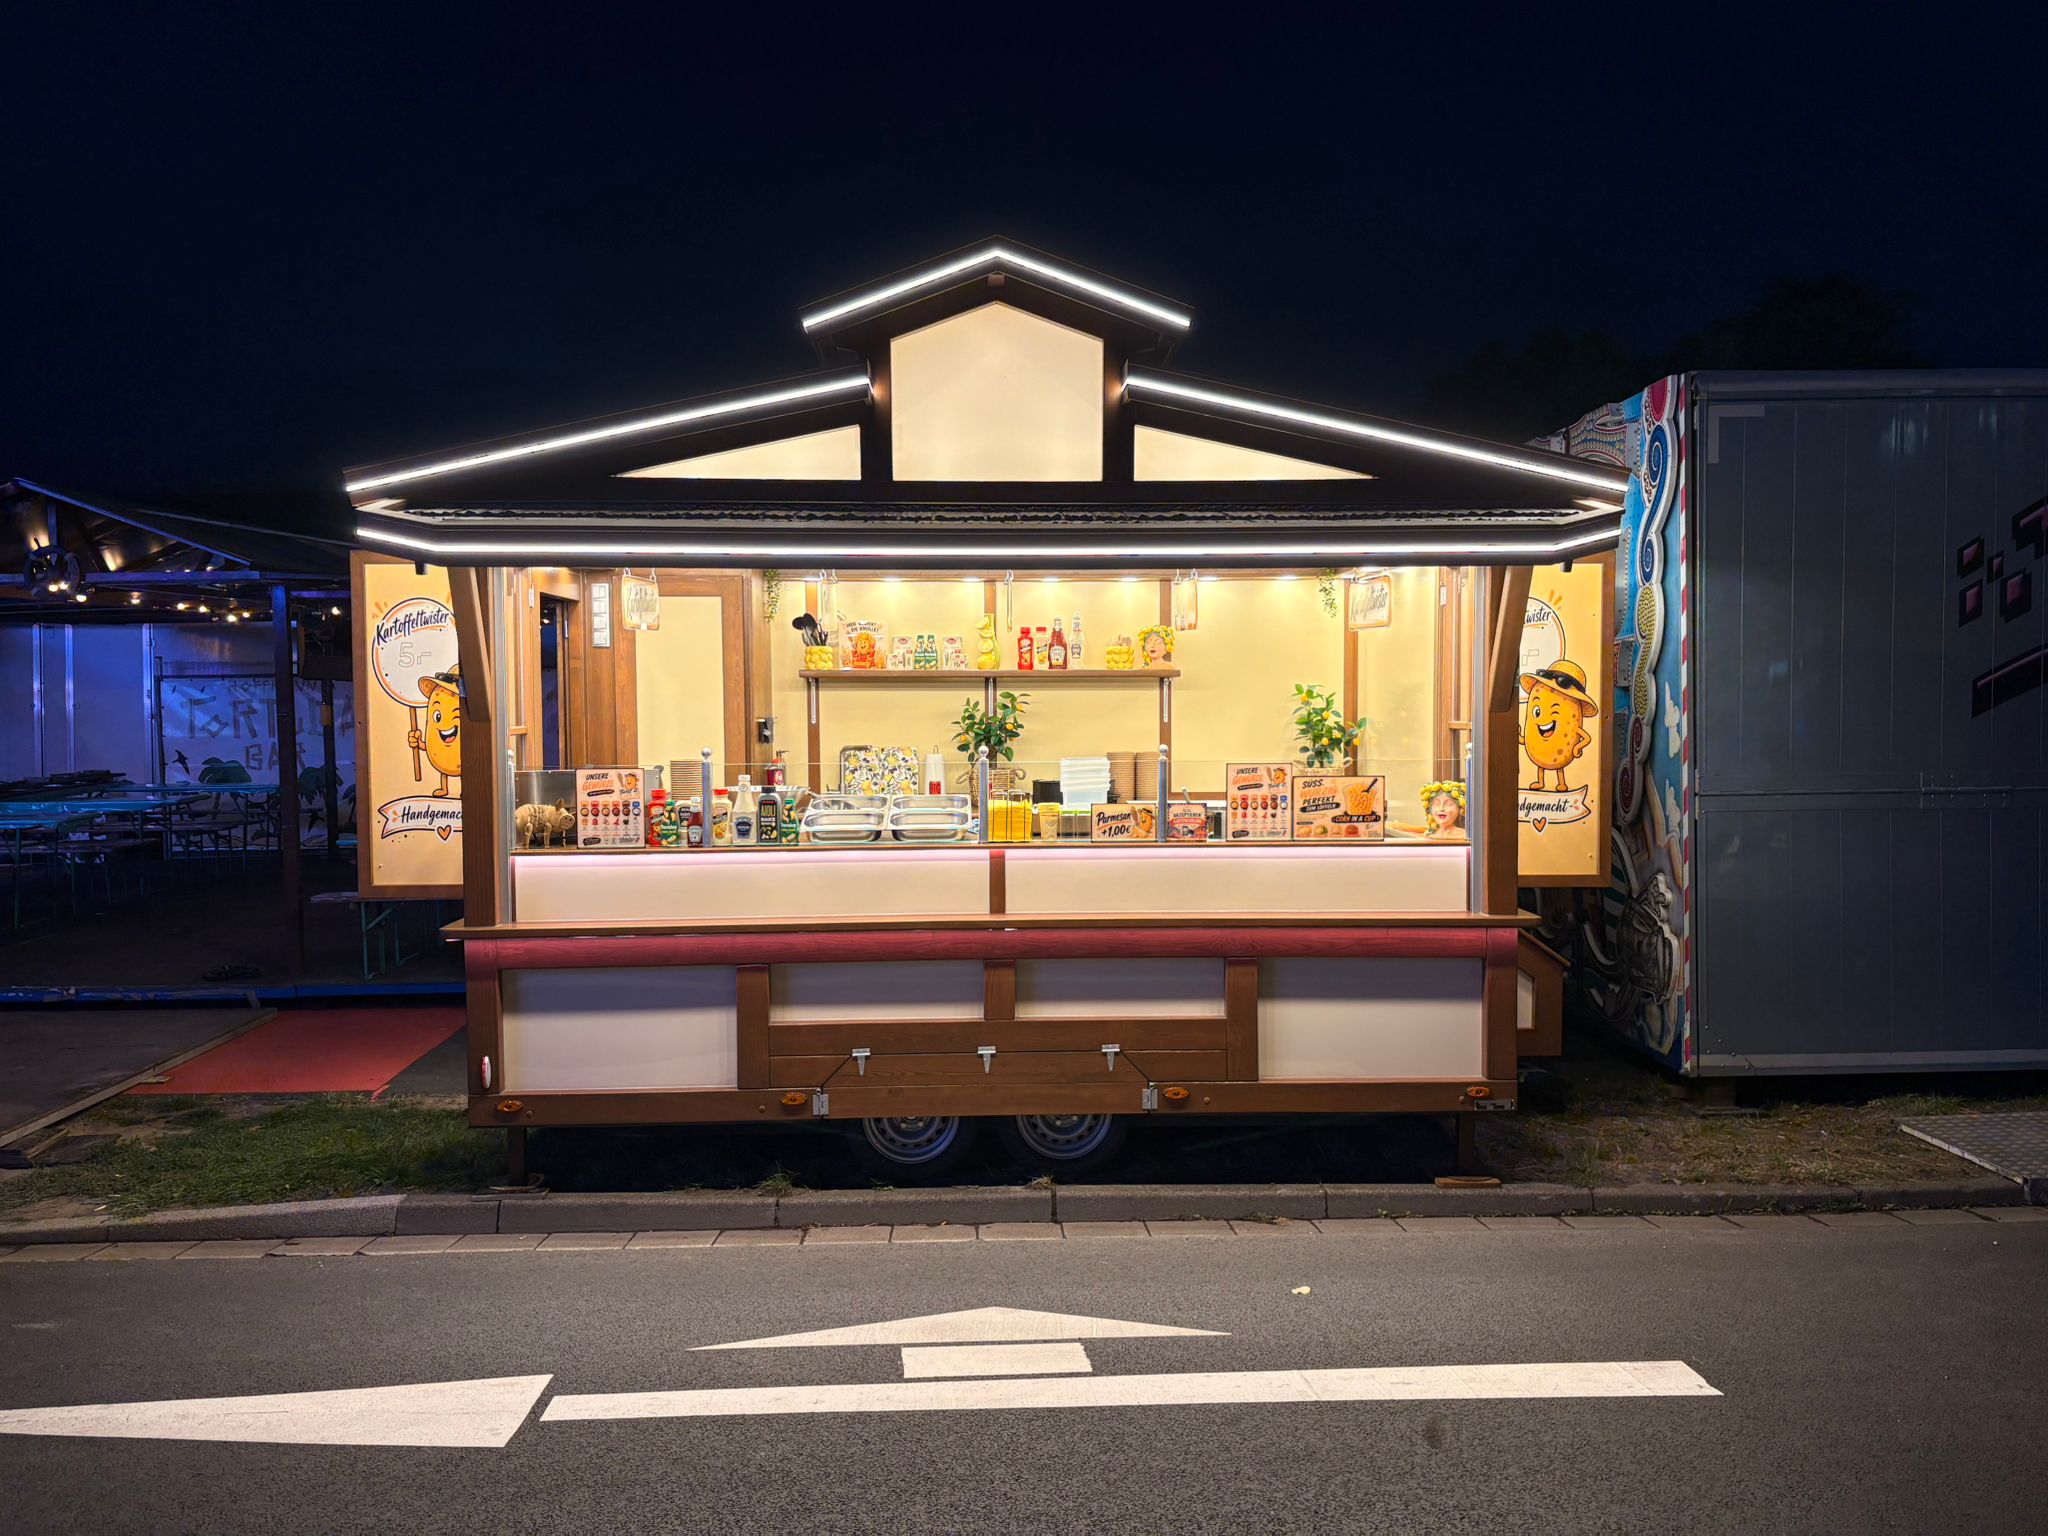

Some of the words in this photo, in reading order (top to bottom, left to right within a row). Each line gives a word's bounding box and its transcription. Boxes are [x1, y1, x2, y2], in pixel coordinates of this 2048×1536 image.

[1526, 606, 1552, 624] wister
[376, 607, 450, 647] Kartoffeltwister
[585, 772, 609, 781] UNSERE
[1236, 767, 1259, 775] UNSERE
[1303, 795, 1336, 806] PERFEKT
[1518, 796, 1570, 818] dgemacht
[401, 804, 463, 826] Handgemac
[1096, 811, 1132, 827] Parmesan
[1101, 824, 1133, 839] +1,00€
